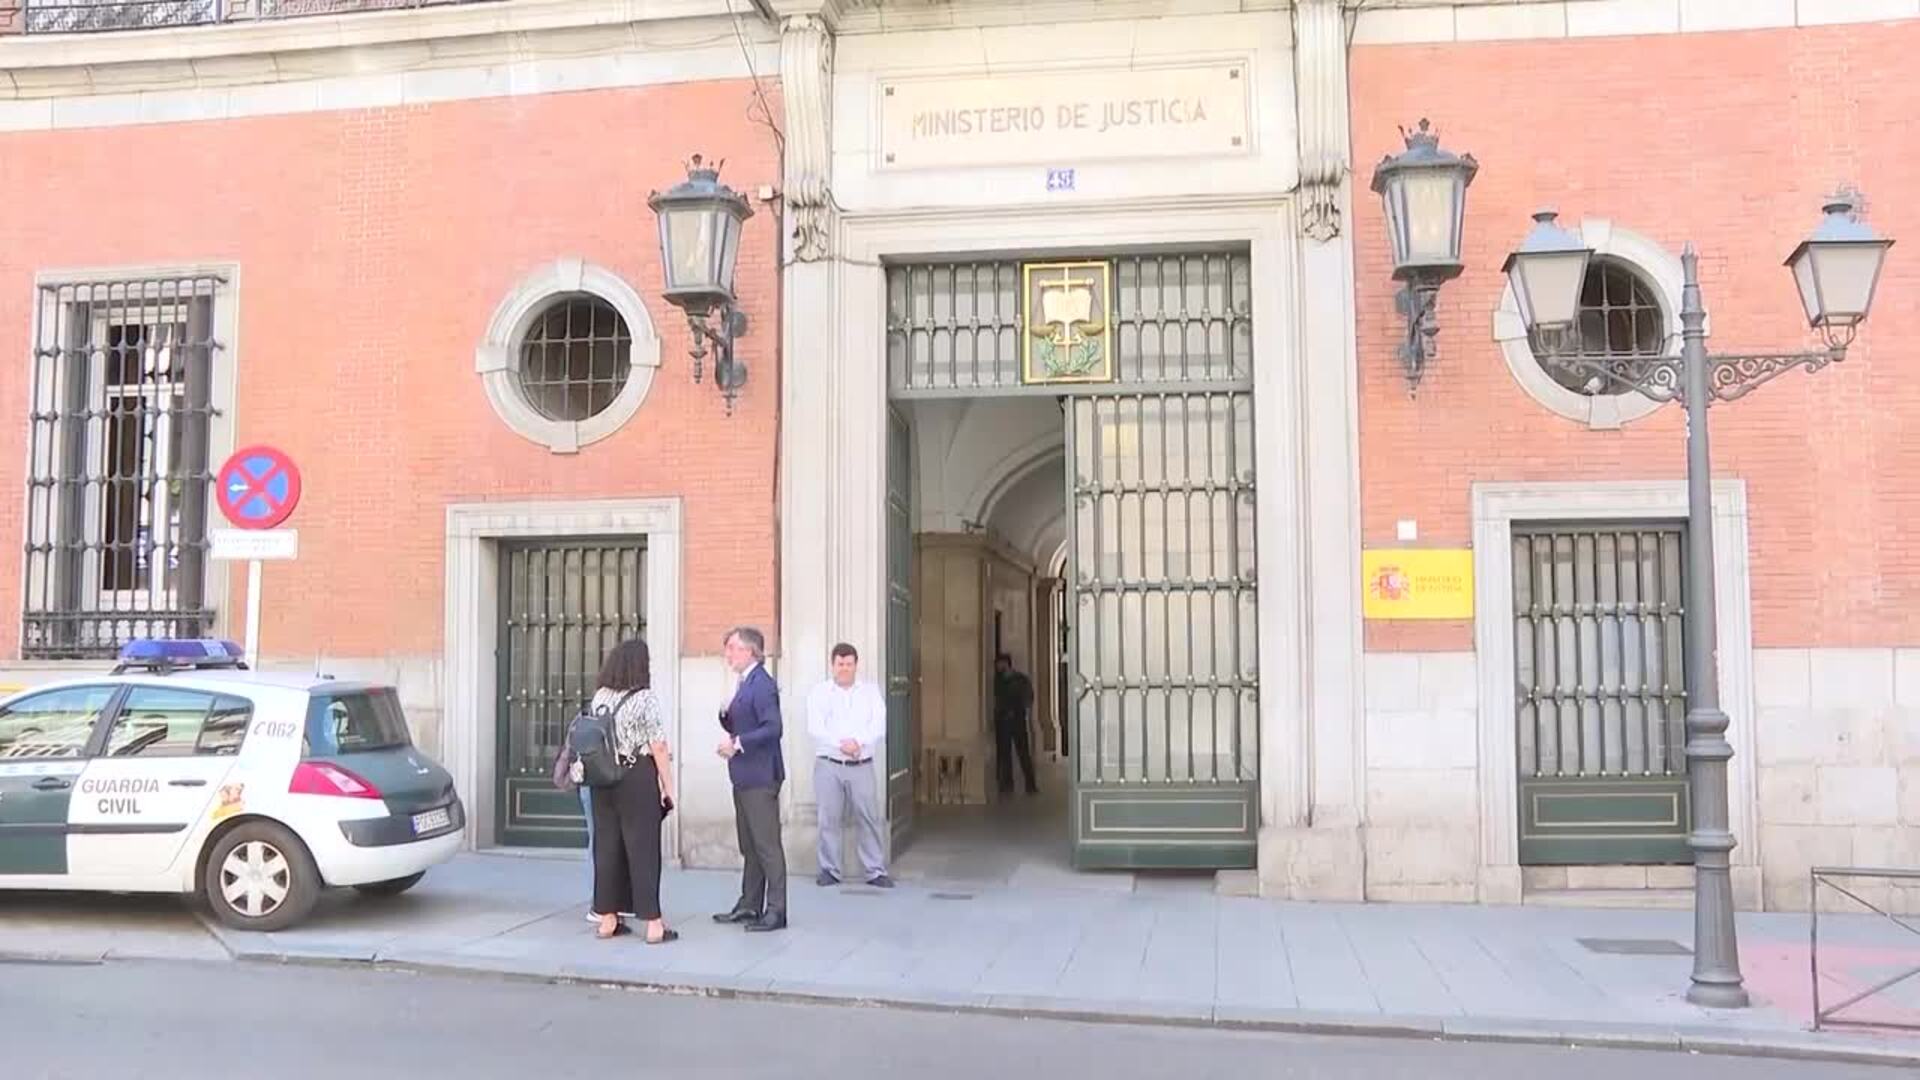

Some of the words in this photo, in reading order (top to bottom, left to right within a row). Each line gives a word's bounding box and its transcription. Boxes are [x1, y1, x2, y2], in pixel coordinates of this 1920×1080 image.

[912, 105, 1045, 139] MINISTERIO
[1056, 103, 1090, 129] DE
[81, 778, 160, 794] GUARDIA
[97, 798, 142, 814] CIVIL
